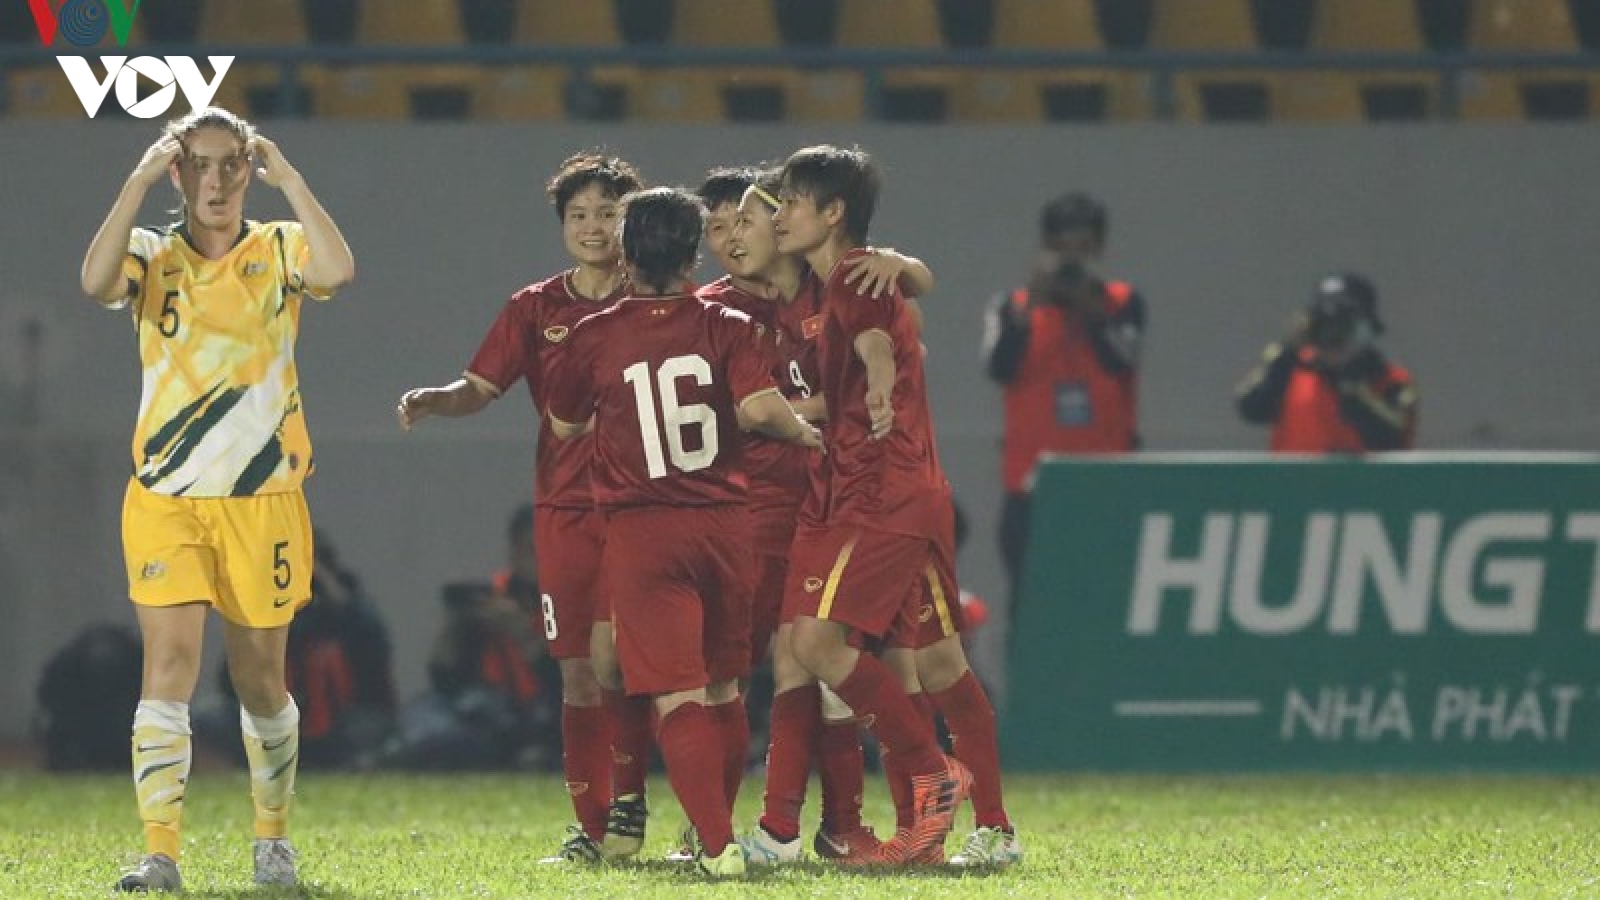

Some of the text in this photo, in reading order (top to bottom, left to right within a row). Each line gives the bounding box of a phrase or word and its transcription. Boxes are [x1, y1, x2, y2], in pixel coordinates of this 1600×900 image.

[158, 290, 179, 338] 5
[788, 360, 810, 399] 9
[623, 354, 719, 478] 16
[273, 540, 291, 591] 5
[1127, 512, 1553, 635] HUNG
[540, 593, 558, 640] 8
